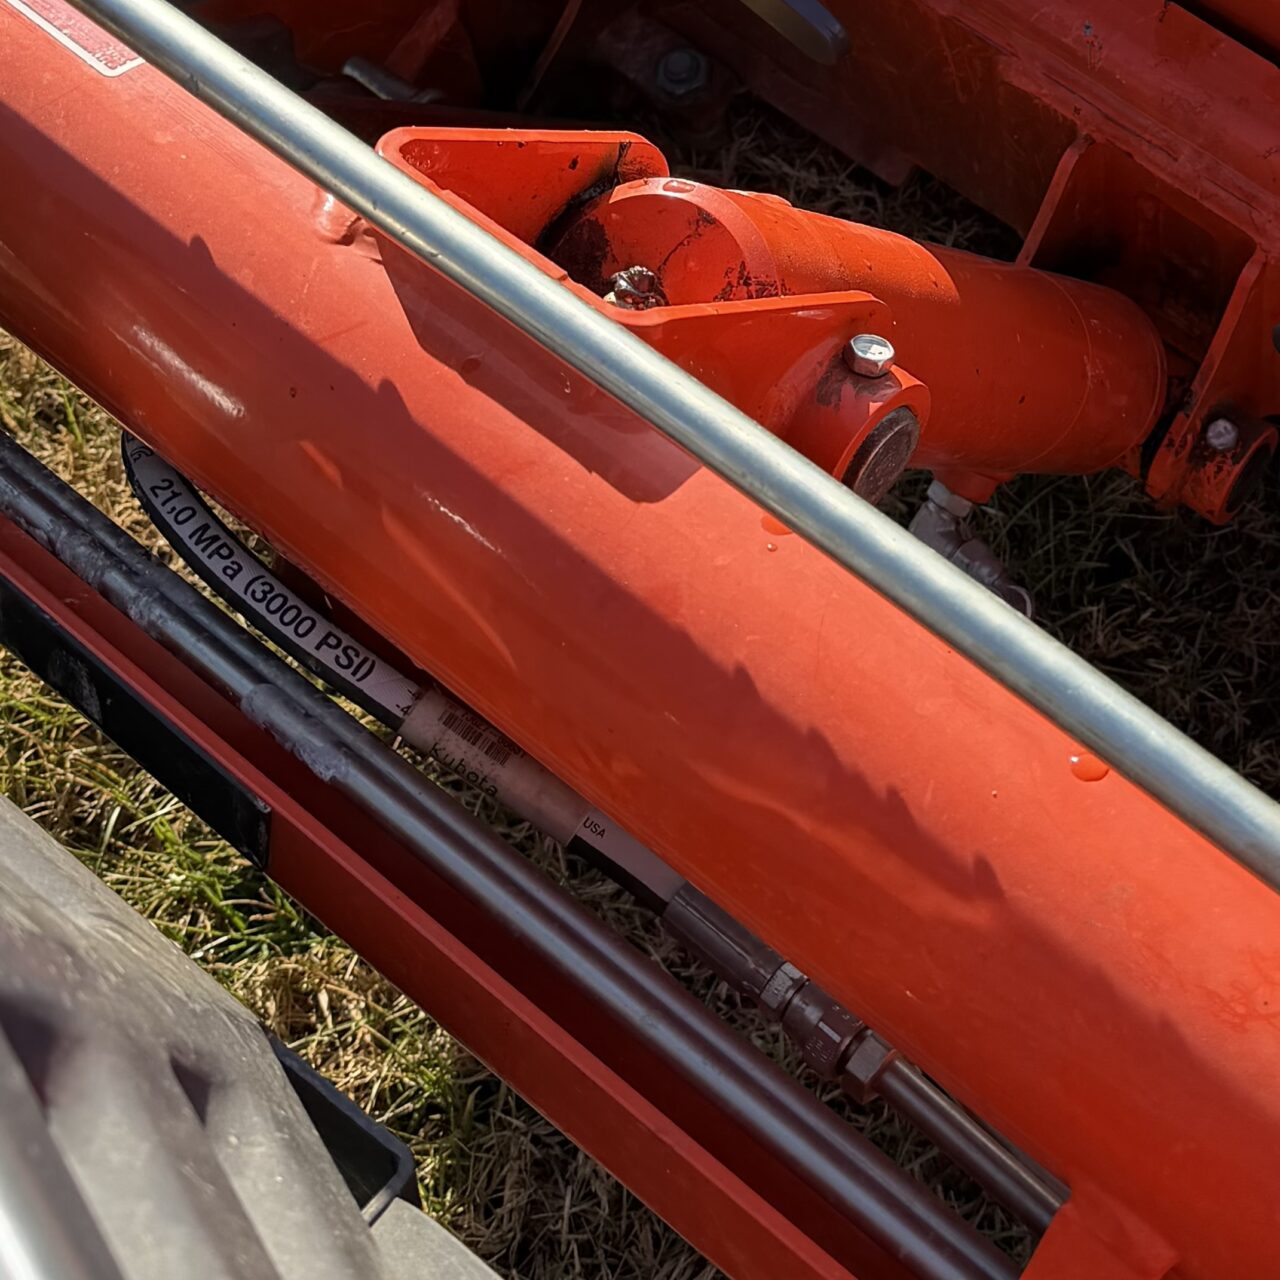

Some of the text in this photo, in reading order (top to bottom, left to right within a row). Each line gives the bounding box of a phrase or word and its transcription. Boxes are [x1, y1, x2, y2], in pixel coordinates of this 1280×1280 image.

[150, 478, 376, 682] 21,0 MPa (3000 PSI)
[430, 742, 498, 797] Kubota
[583, 816, 606, 839] USA
